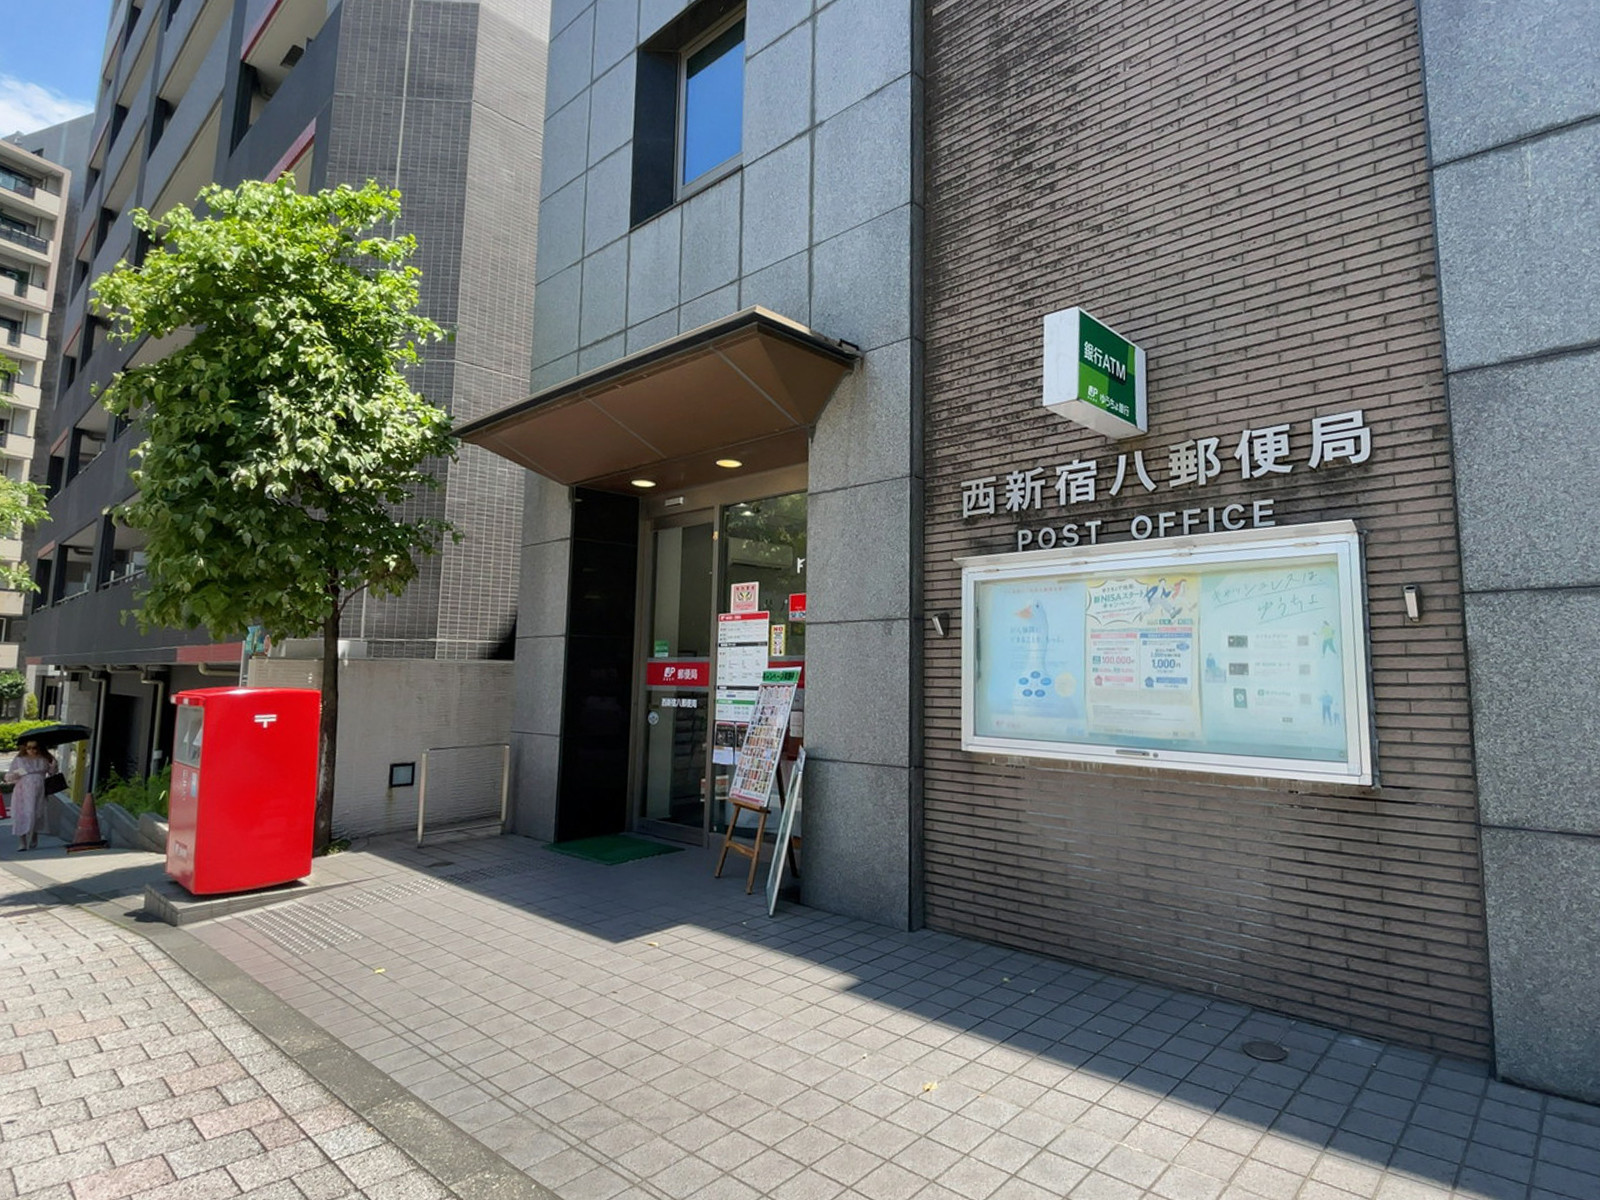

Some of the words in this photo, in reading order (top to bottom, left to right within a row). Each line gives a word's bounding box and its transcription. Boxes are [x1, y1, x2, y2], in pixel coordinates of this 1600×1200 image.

[1083, 340, 1127, 382] 銀行ATM
[1099, 393, 1130, 417] ゆうちょ銀行
[960, 409, 1373, 519] 西新宿八郵便局
[1016, 520, 1102, 553] POST
[1130, 500, 1276, 540] OFFICE
[1257, 594, 1320, 619] ゆうちょ
[677, 668, 698, 680] 郵便局
